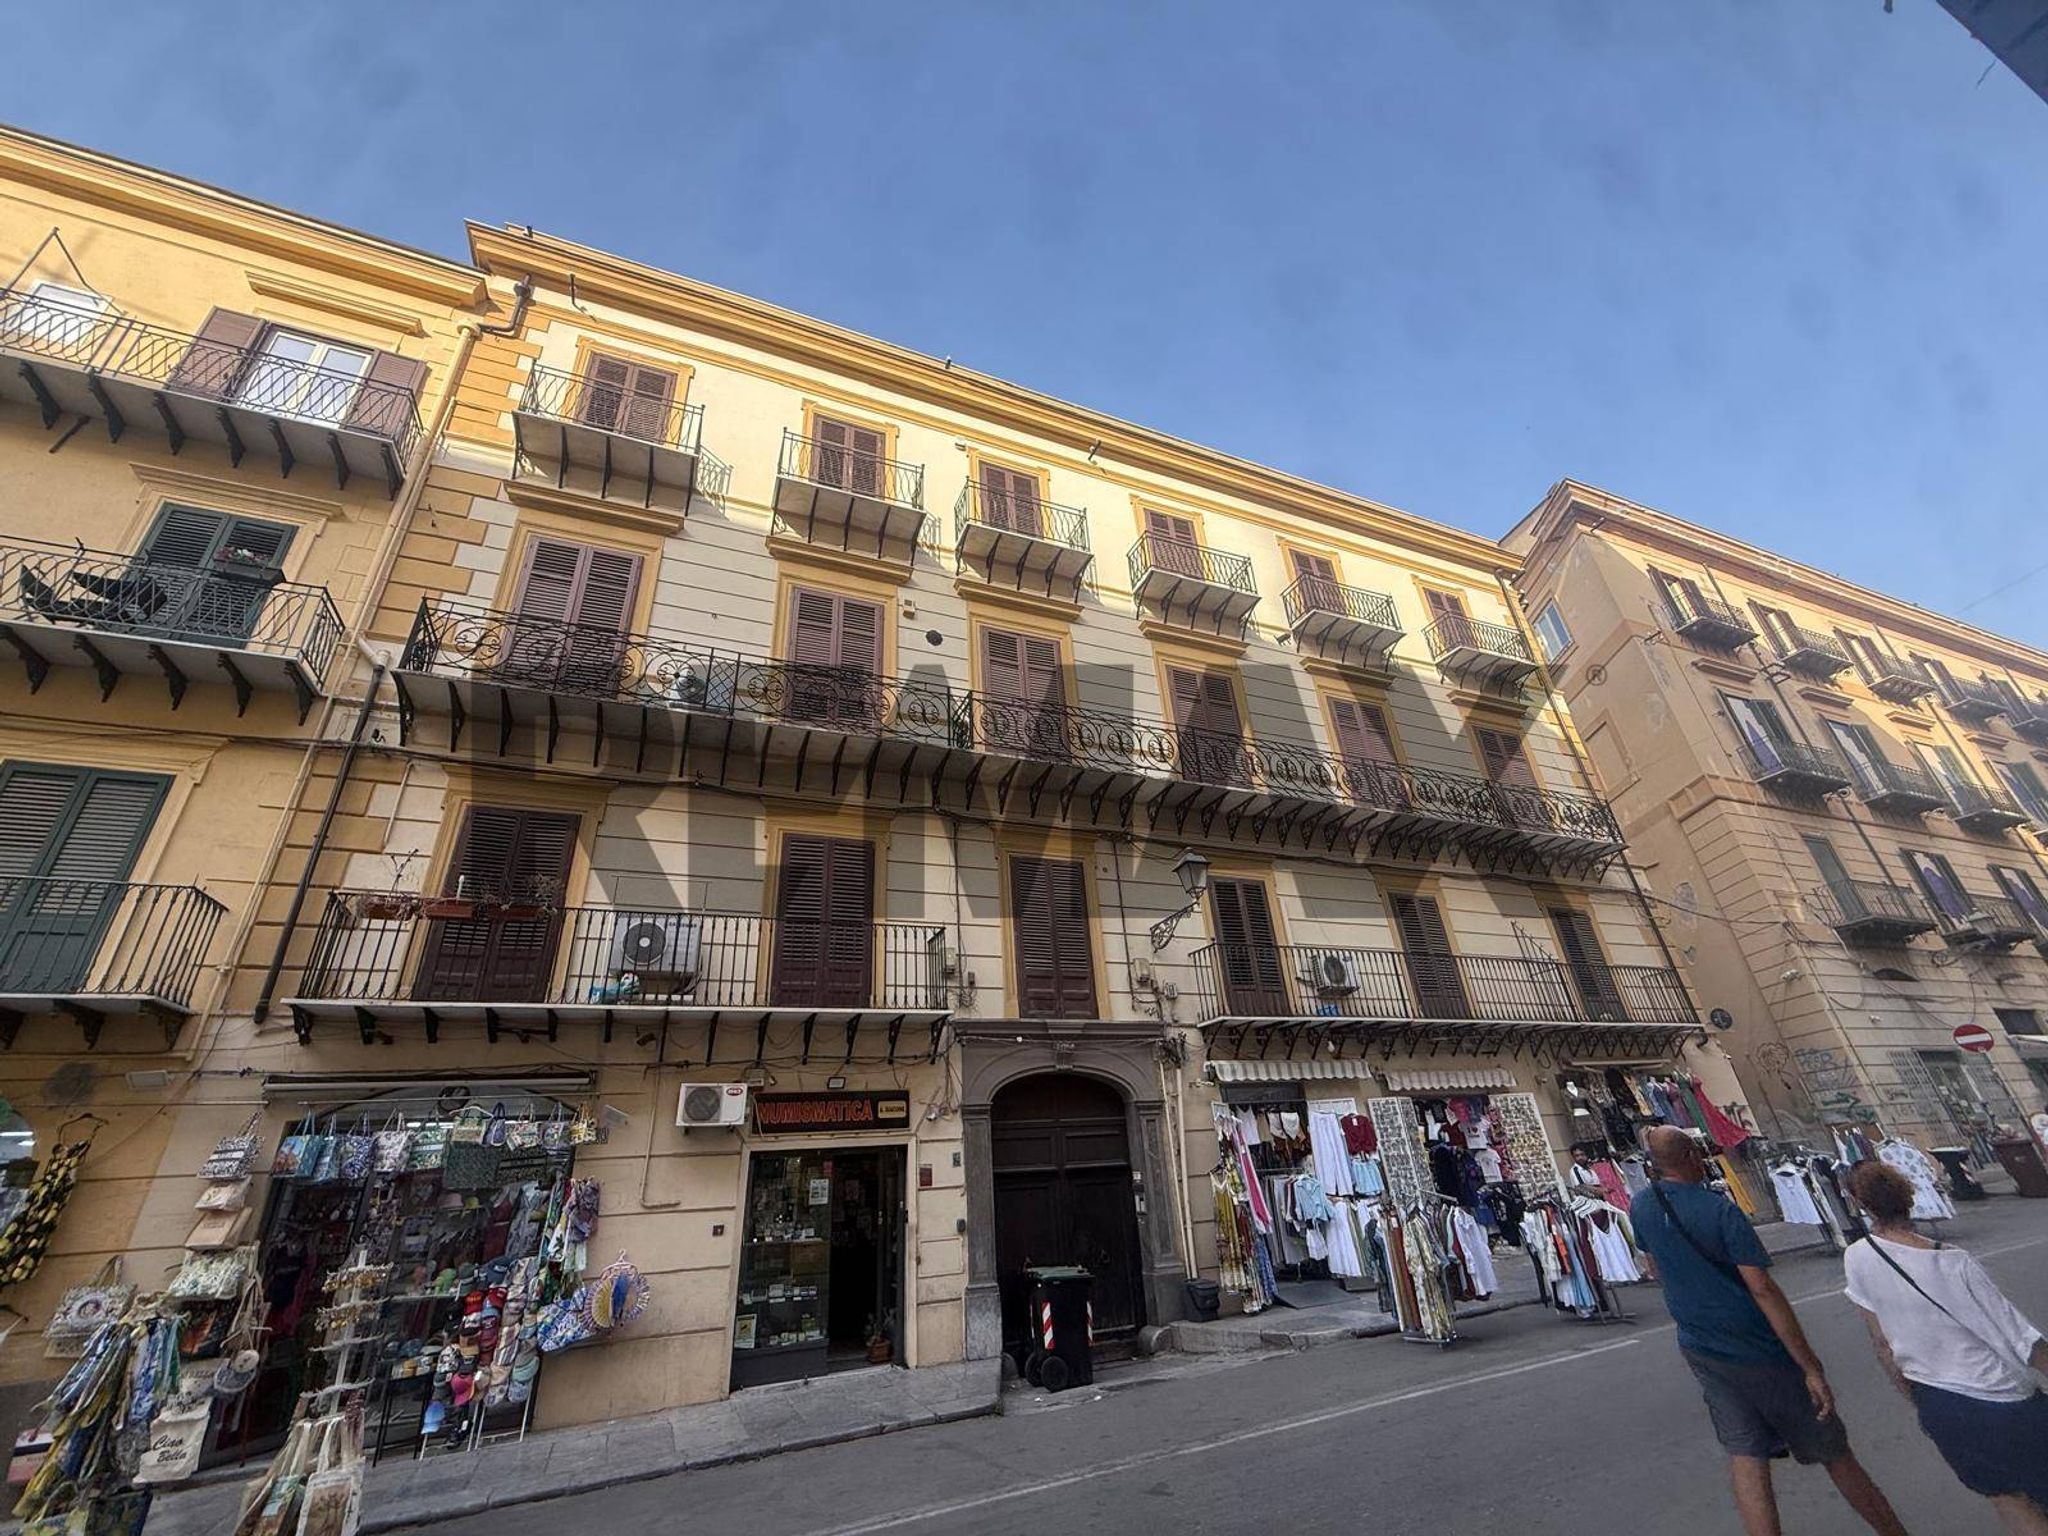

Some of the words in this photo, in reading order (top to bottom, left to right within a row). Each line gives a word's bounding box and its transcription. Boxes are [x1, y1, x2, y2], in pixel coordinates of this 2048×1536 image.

[757, 1100, 873, 1124] NUMISMATICA
[152, 1434, 183, 1451] Ciao
[157, 1448, 187, 1463] Bella
